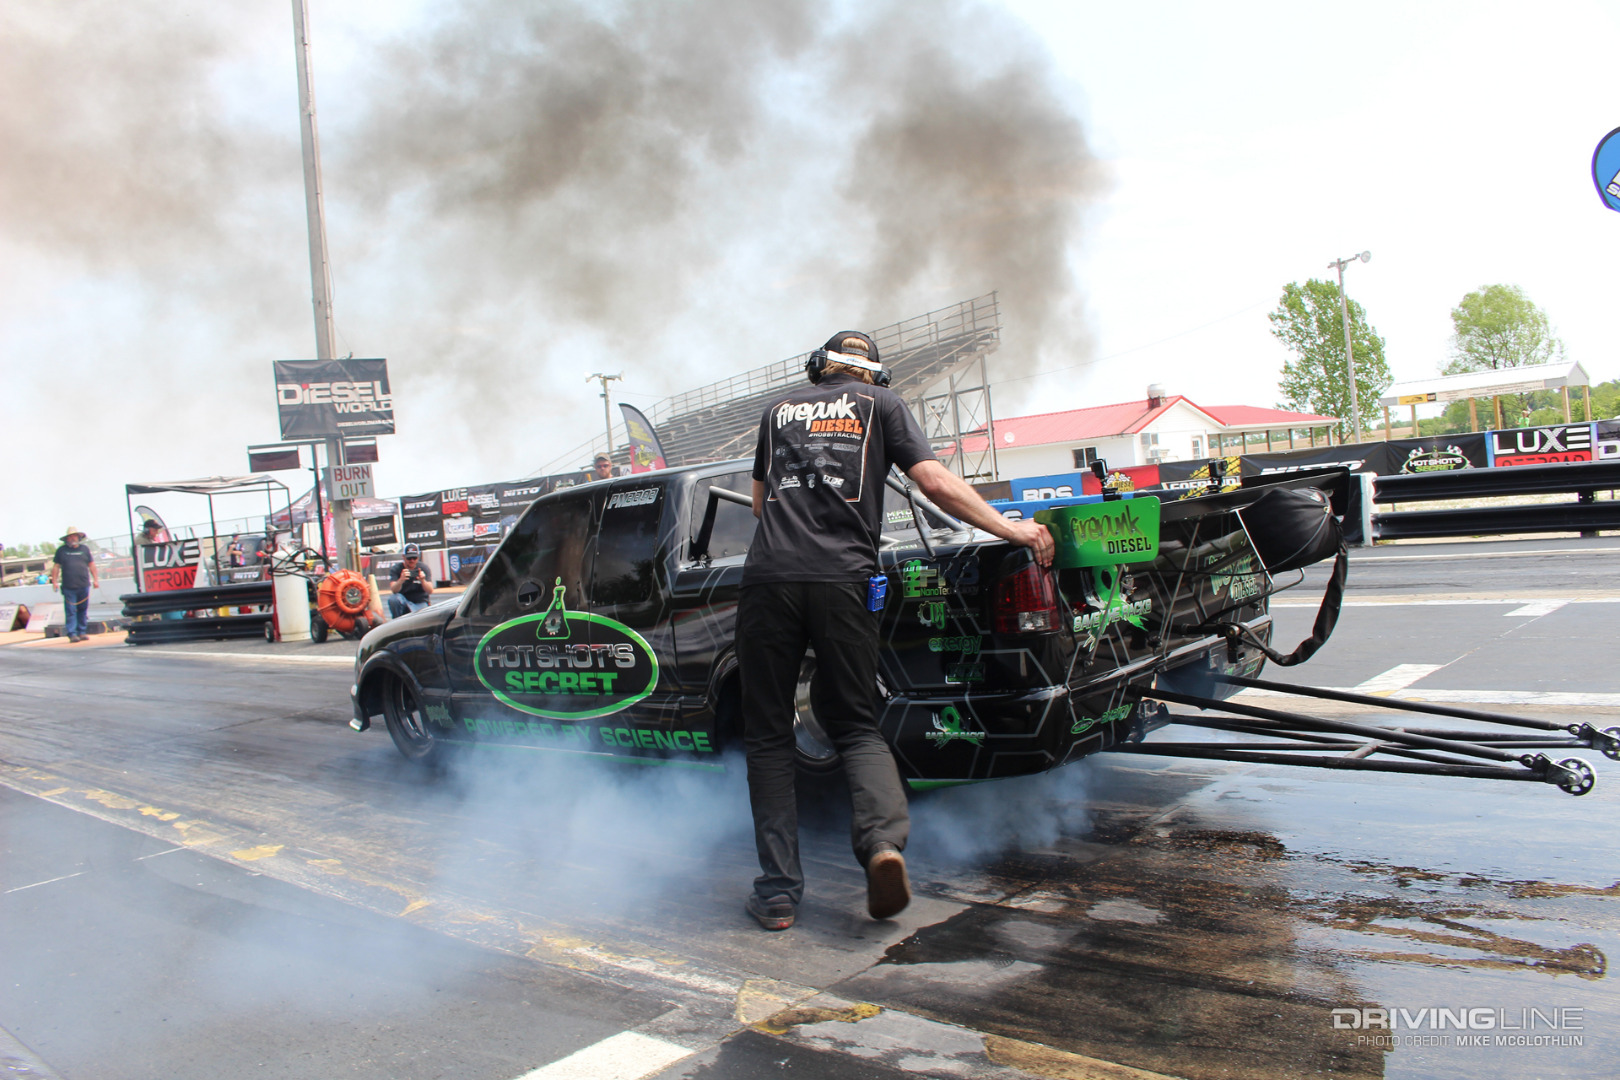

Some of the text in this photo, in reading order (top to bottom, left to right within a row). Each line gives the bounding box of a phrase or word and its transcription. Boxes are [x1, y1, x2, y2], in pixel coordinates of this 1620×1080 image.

[277, 380, 392, 405] DIESEL
[335, 401, 393, 413] WORLD
[776, 393, 856, 430] firepunk
[810, 419, 863, 434] DIESEL
[1493, 426, 1591, 455] LUXE
[334, 465, 370, 482] BURN
[1415, 464, 1456, 473] SECRET
[341, 482, 367, 497] OUT
[442, 488, 468, 502] LUXE
[1022, 485, 1073, 501] BDS
[1070, 505, 1144, 553] firepunk
[141, 538, 200, 568] LUXE
[1107, 537, 1152, 555] DIESEL
[504, 670, 618, 696] SECRET
[463, 718, 713, 752] POWERED BY SCIENCE
